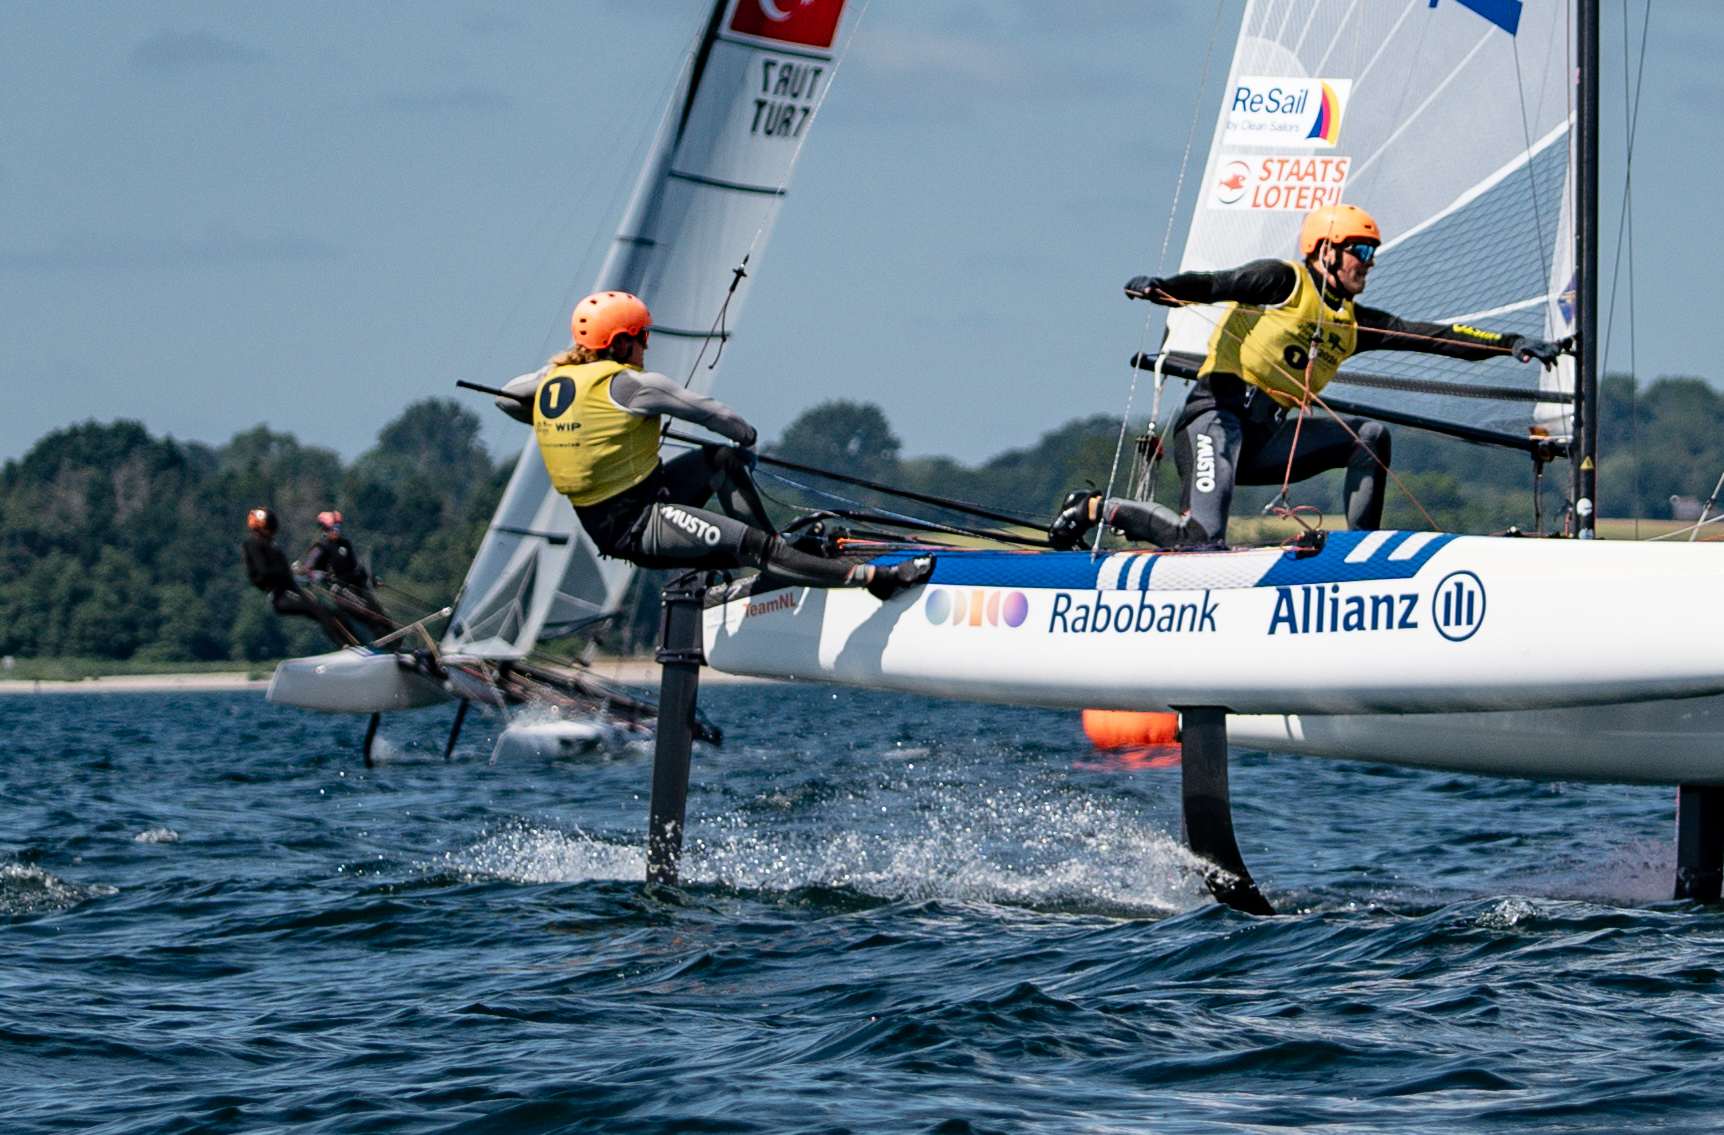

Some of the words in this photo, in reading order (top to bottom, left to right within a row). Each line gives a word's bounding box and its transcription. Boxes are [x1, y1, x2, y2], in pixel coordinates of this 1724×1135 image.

[1231, 86, 1310, 115] ReSail
[751, 98, 811, 137] TUR7
[1259, 157, 1348, 183] STAATS
[548, 382, 561, 410] 1
[555, 421, 582, 432] WIP
[1196, 433, 1216, 493] MUSTO
[661, 505, 721, 547] MUSTO
[743, 591, 797, 618] TeamNL
[1048, 590, 1220, 634] Rabobank
[1267, 583, 1419, 636] Allianz
